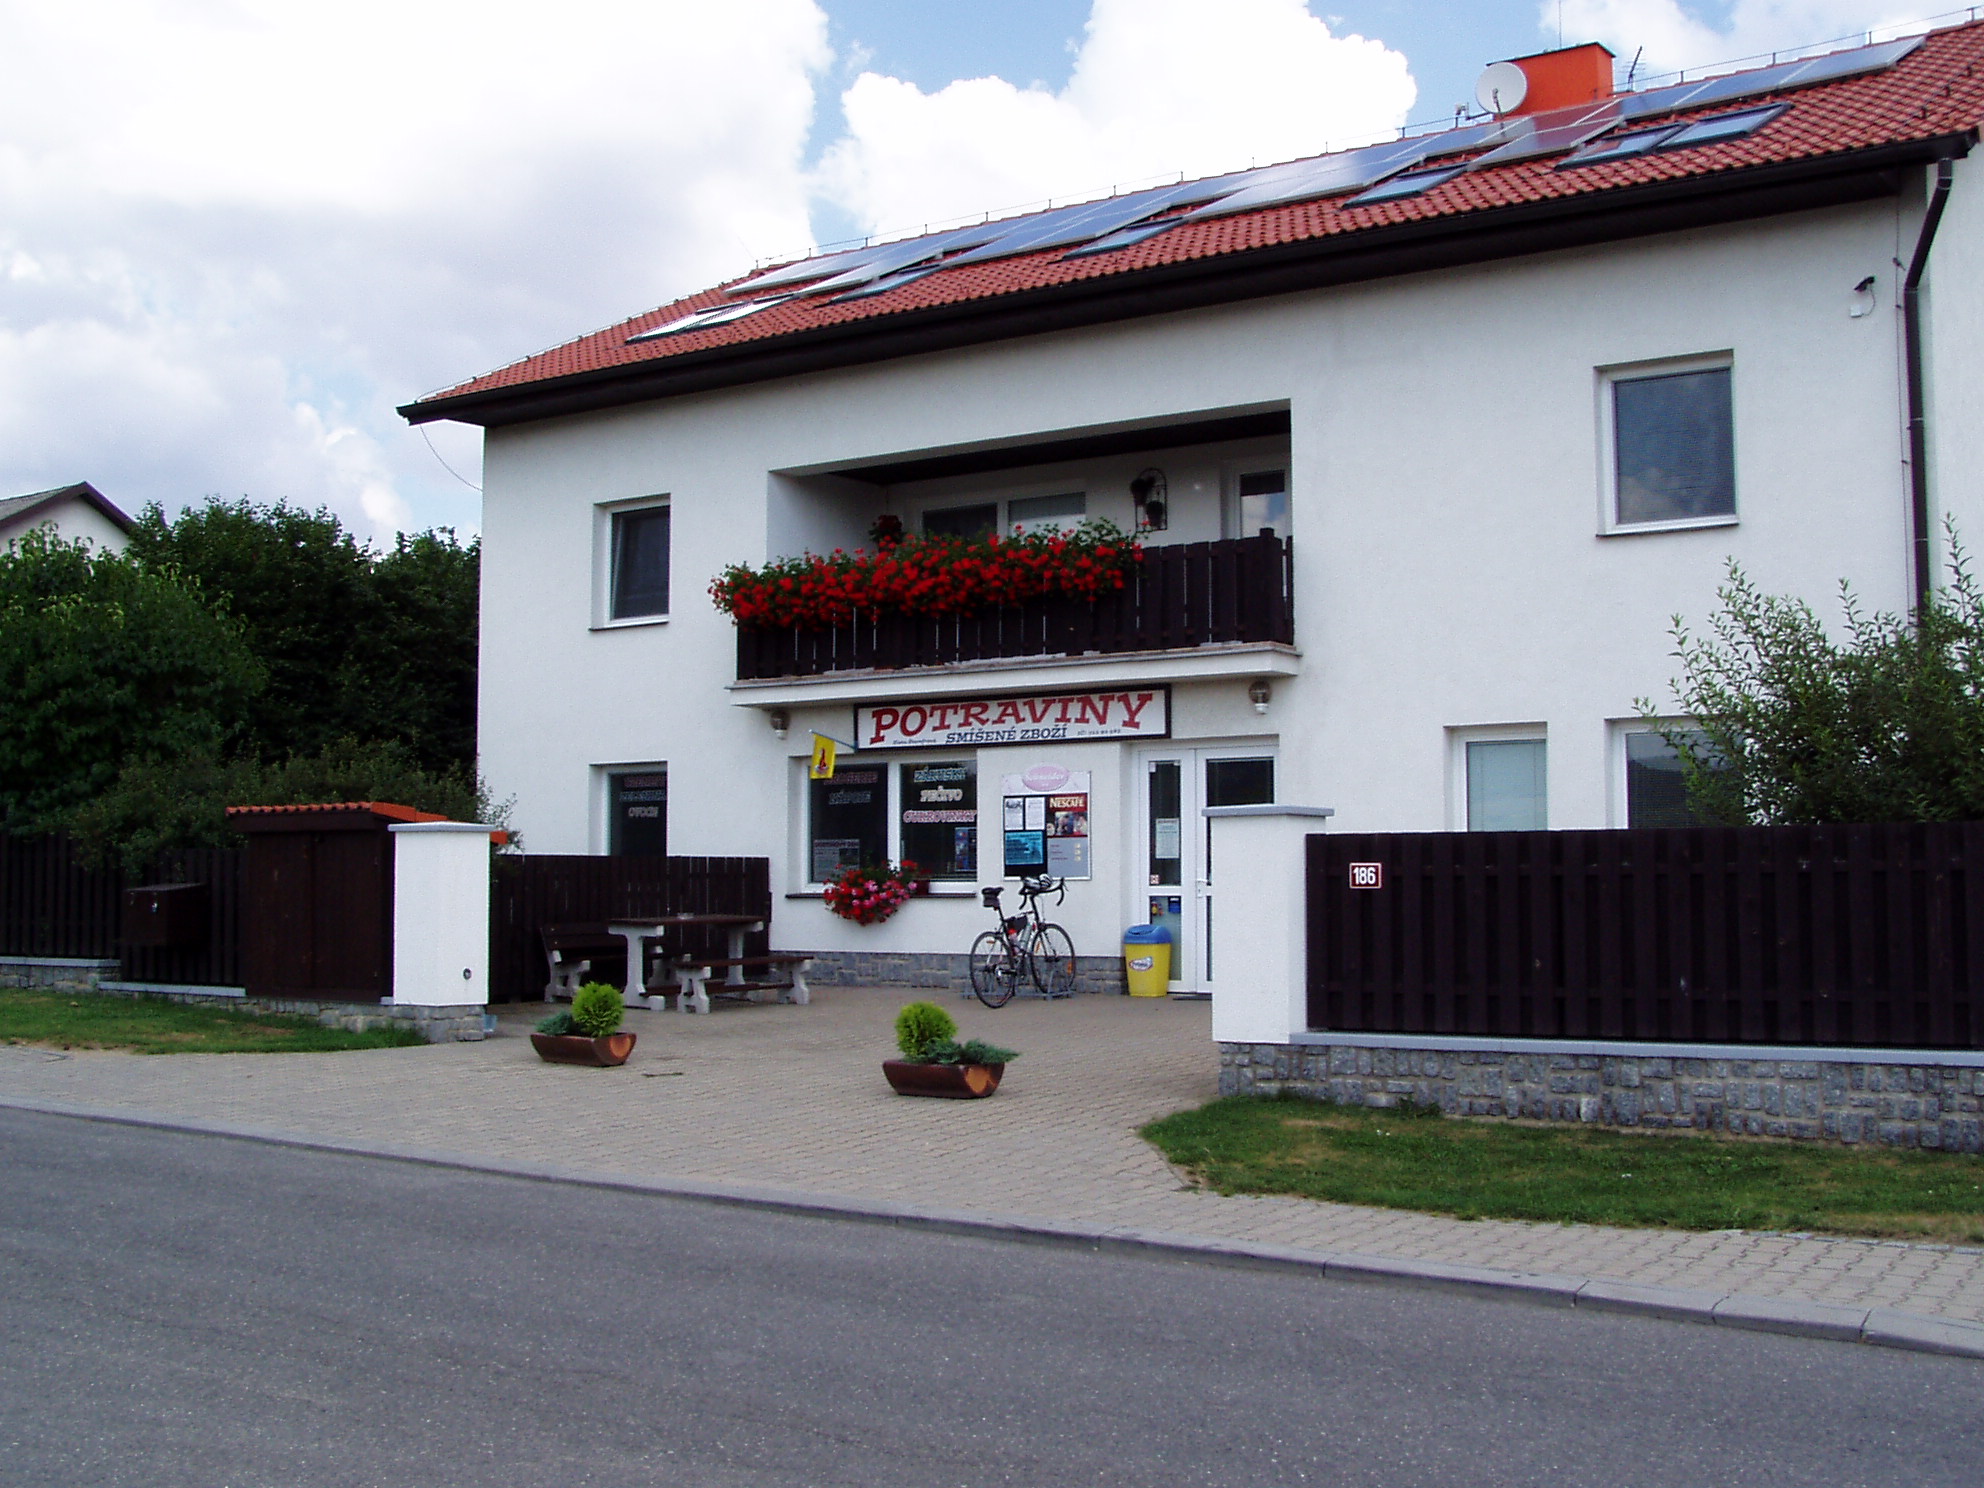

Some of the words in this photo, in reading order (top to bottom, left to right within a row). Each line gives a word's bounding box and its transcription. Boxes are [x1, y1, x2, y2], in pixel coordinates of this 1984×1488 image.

[869, 692, 1153, 746] POTRAVINY
[945, 726, 1017, 745] SMÍŠENÉ
[1020, 722, 1068, 739] ZBOŽÍ
[919, 785, 964, 802] PEČIVO
[902, 808, 977, 824] CUKROVINKY
[1352, 866, 1377, 885] 186
